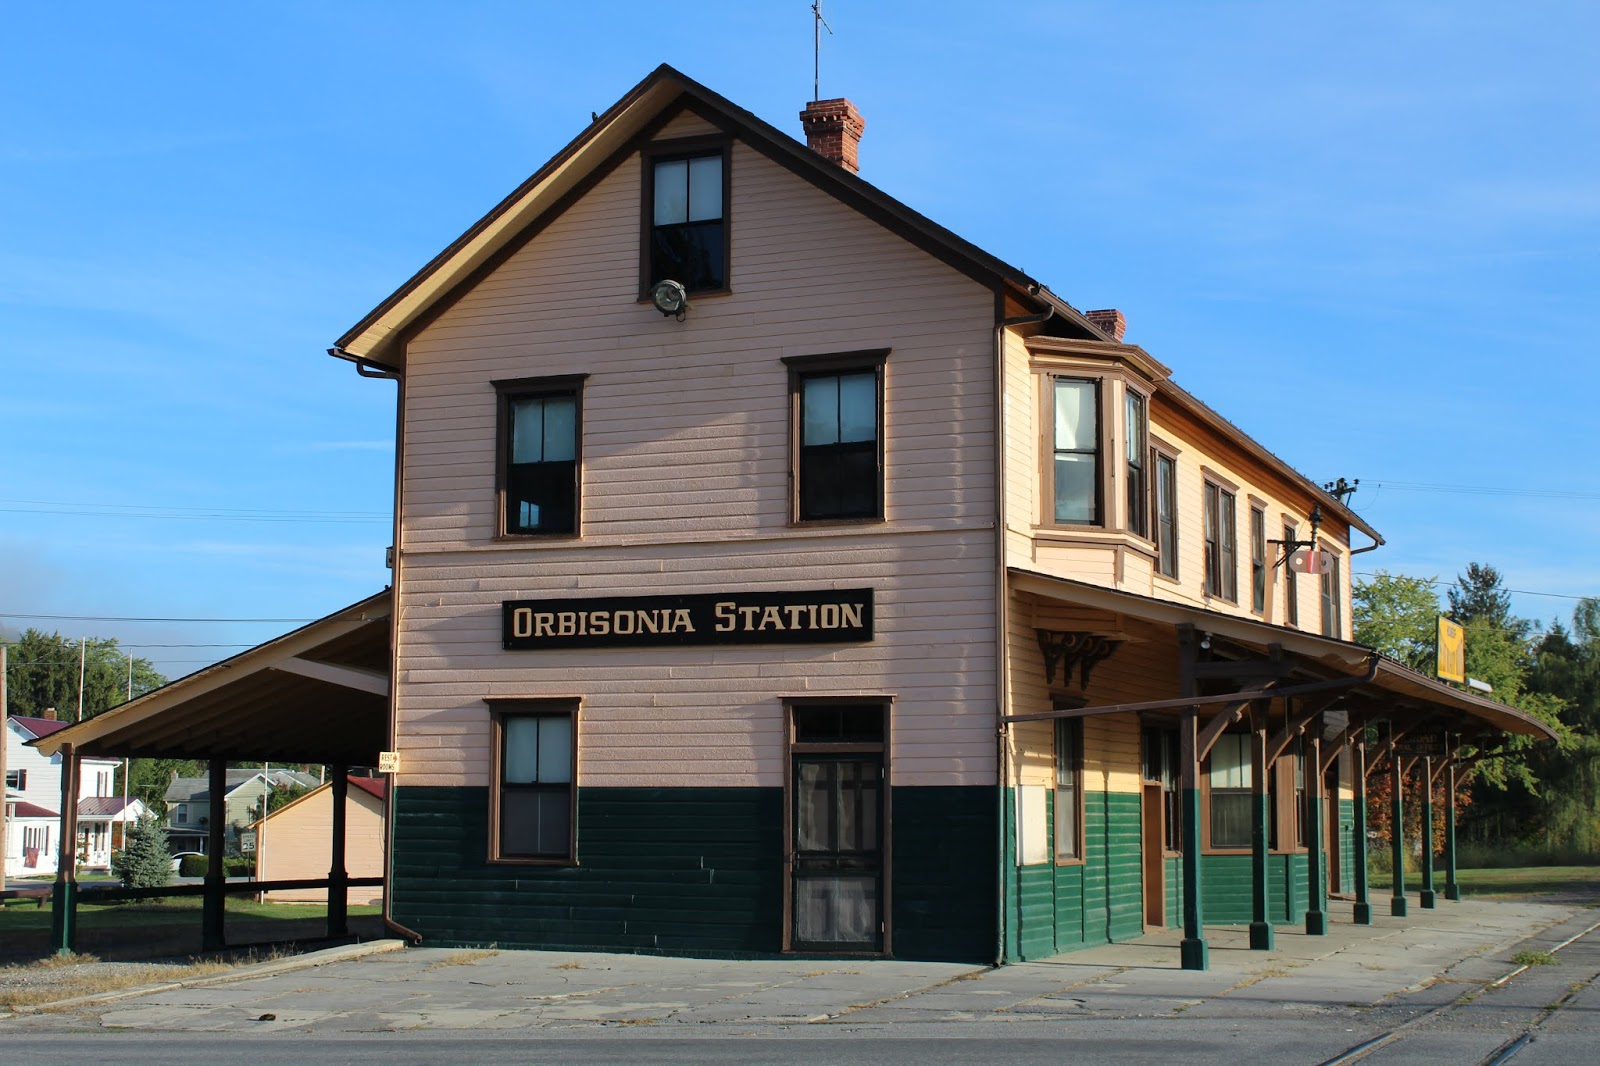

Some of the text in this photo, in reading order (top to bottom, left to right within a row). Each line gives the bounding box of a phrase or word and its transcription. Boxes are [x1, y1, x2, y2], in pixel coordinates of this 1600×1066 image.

[513, 601, 864, 638] ORBISONIA STATION
[381, 754, 393, 762] REST
[380, 763, 395, 771] ROOMS
[242, 842, 255, 851] 25
